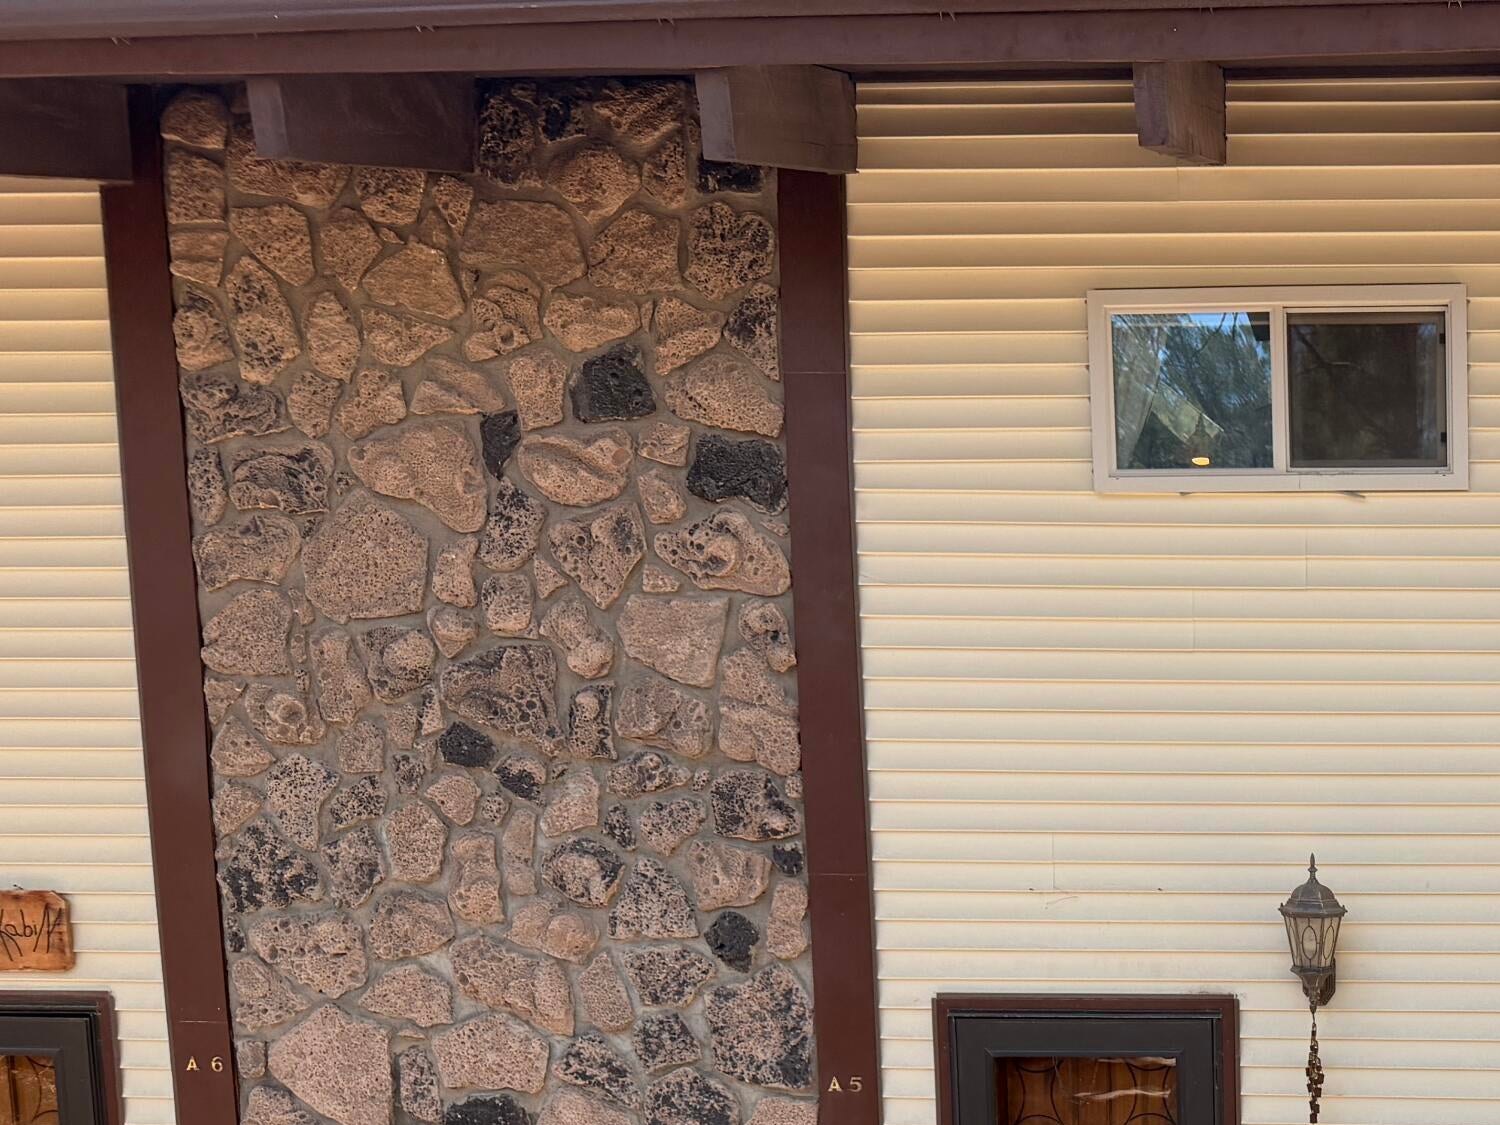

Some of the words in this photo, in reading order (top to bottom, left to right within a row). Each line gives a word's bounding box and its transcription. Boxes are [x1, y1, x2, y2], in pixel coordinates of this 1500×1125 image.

[186, 1056, 200, 1071] A
[211, 1056, 223, 1072] 6
[828, 1076, 843, 1092] A
[848, 1076, 862, 1092] 5
